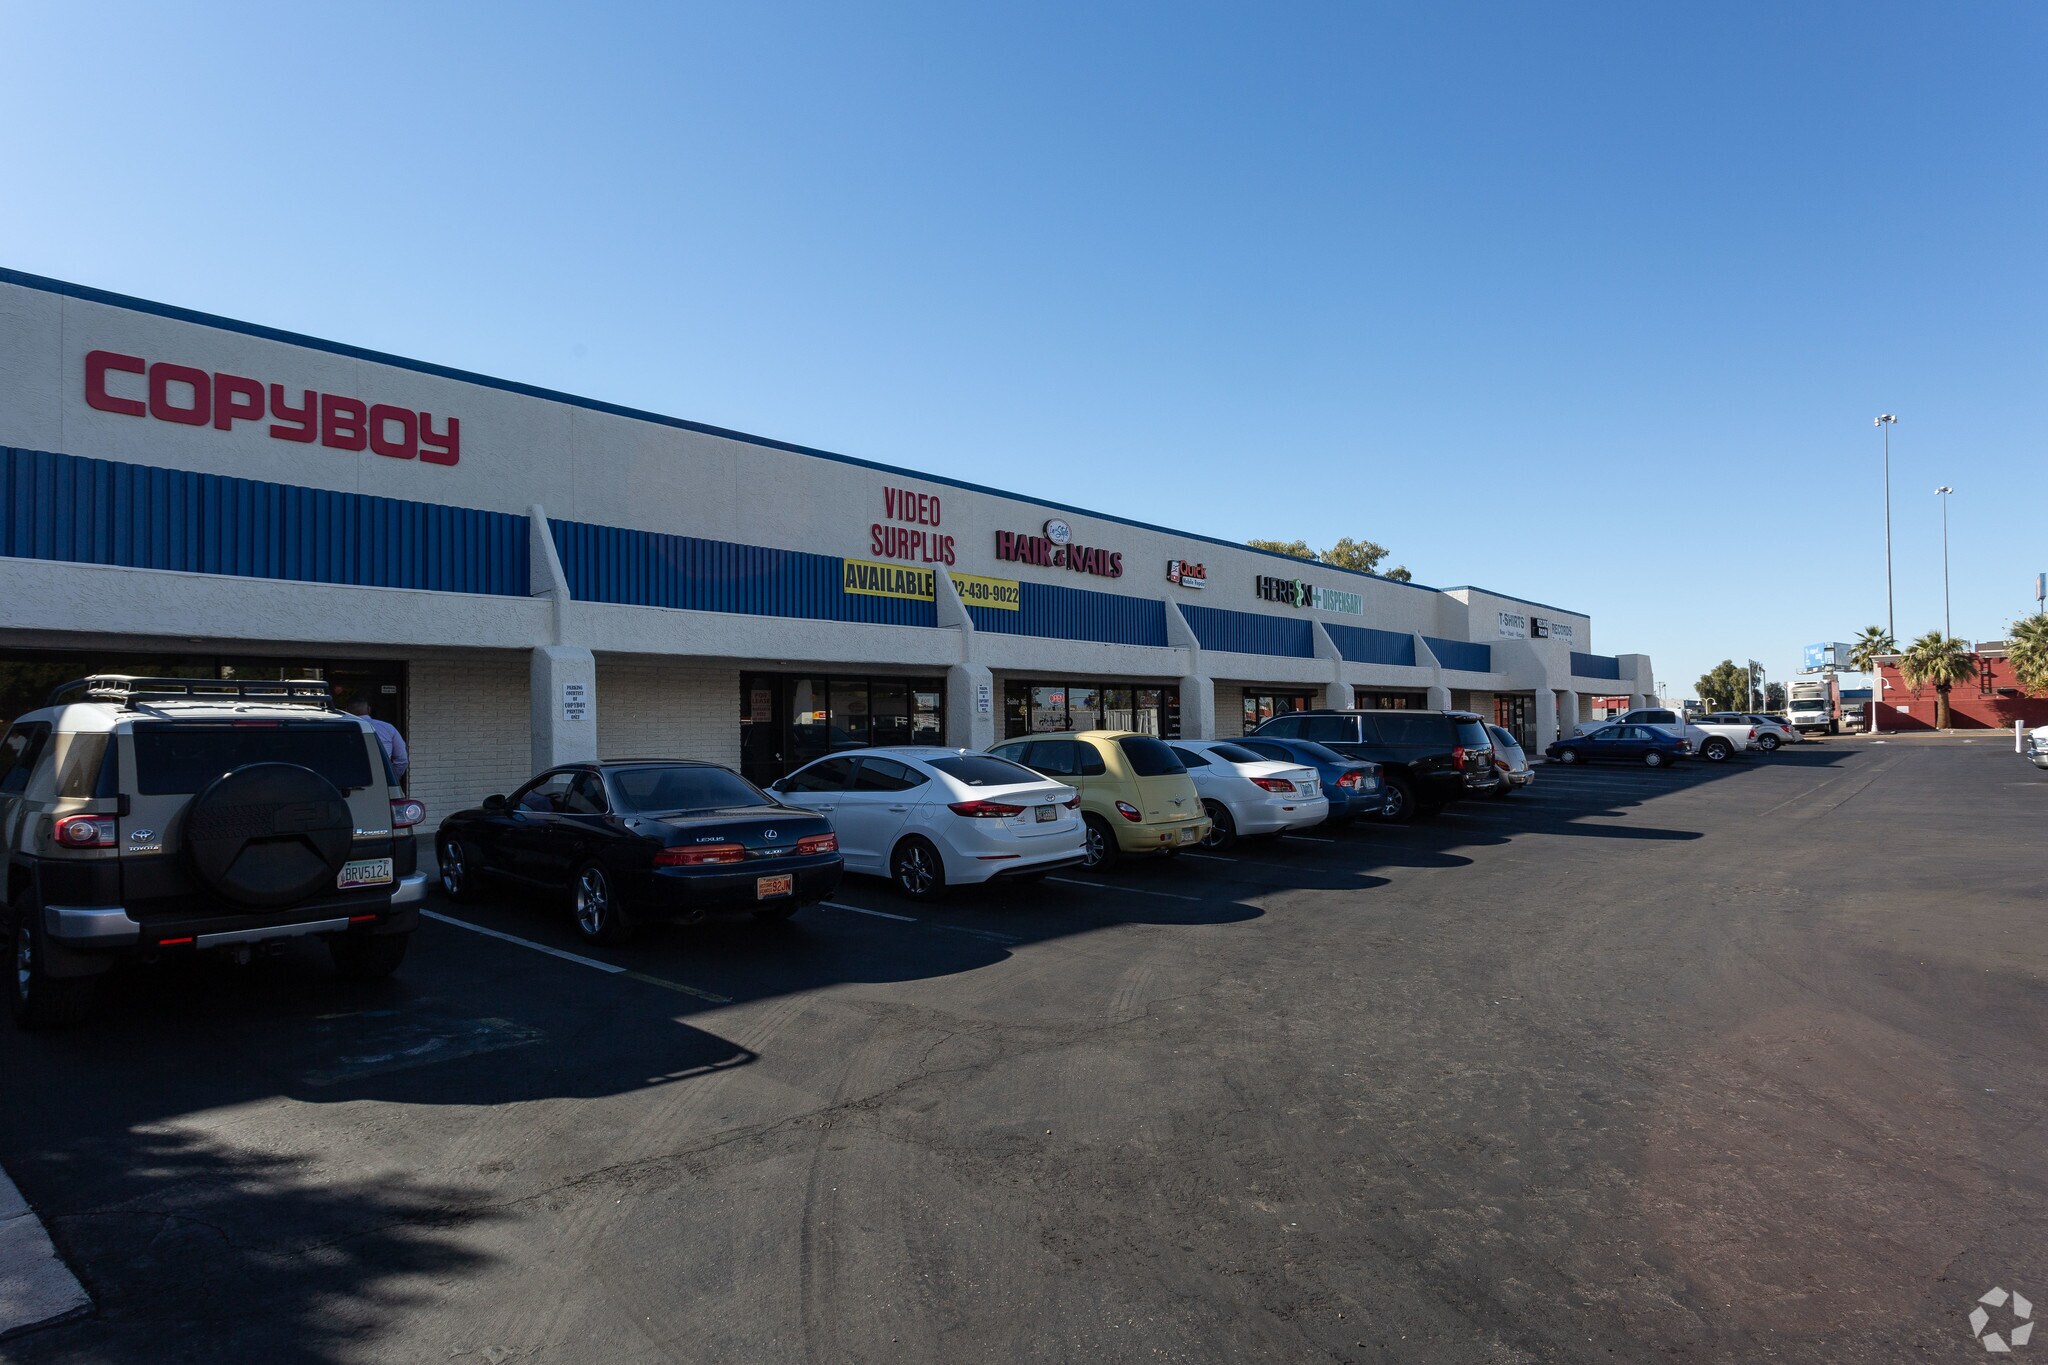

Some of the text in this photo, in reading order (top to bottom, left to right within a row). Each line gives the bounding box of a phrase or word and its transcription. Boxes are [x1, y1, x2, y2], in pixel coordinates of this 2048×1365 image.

[85, 349, 460, 466] COPYBOY
[883, 486, 941, 527] VIDEO
[871, 523, 956, 566] SURPLUS
[996, 529, 1052, 567] HAIR
[1066, 543, 1123, 577] NAILS
[845, 563, 934, 596] AVAILABLE
[1180, 559, 1207, 579] Quick
[1322, 588, 1362, 615] DISPENSARY
[1499, 612, 1525, 629] T-SHIRTS
[1551, 623, 1573, 637] RECORDS
[345, 864, 389, 881] BRV5124
[772, 880, 791, 892] 92JN
